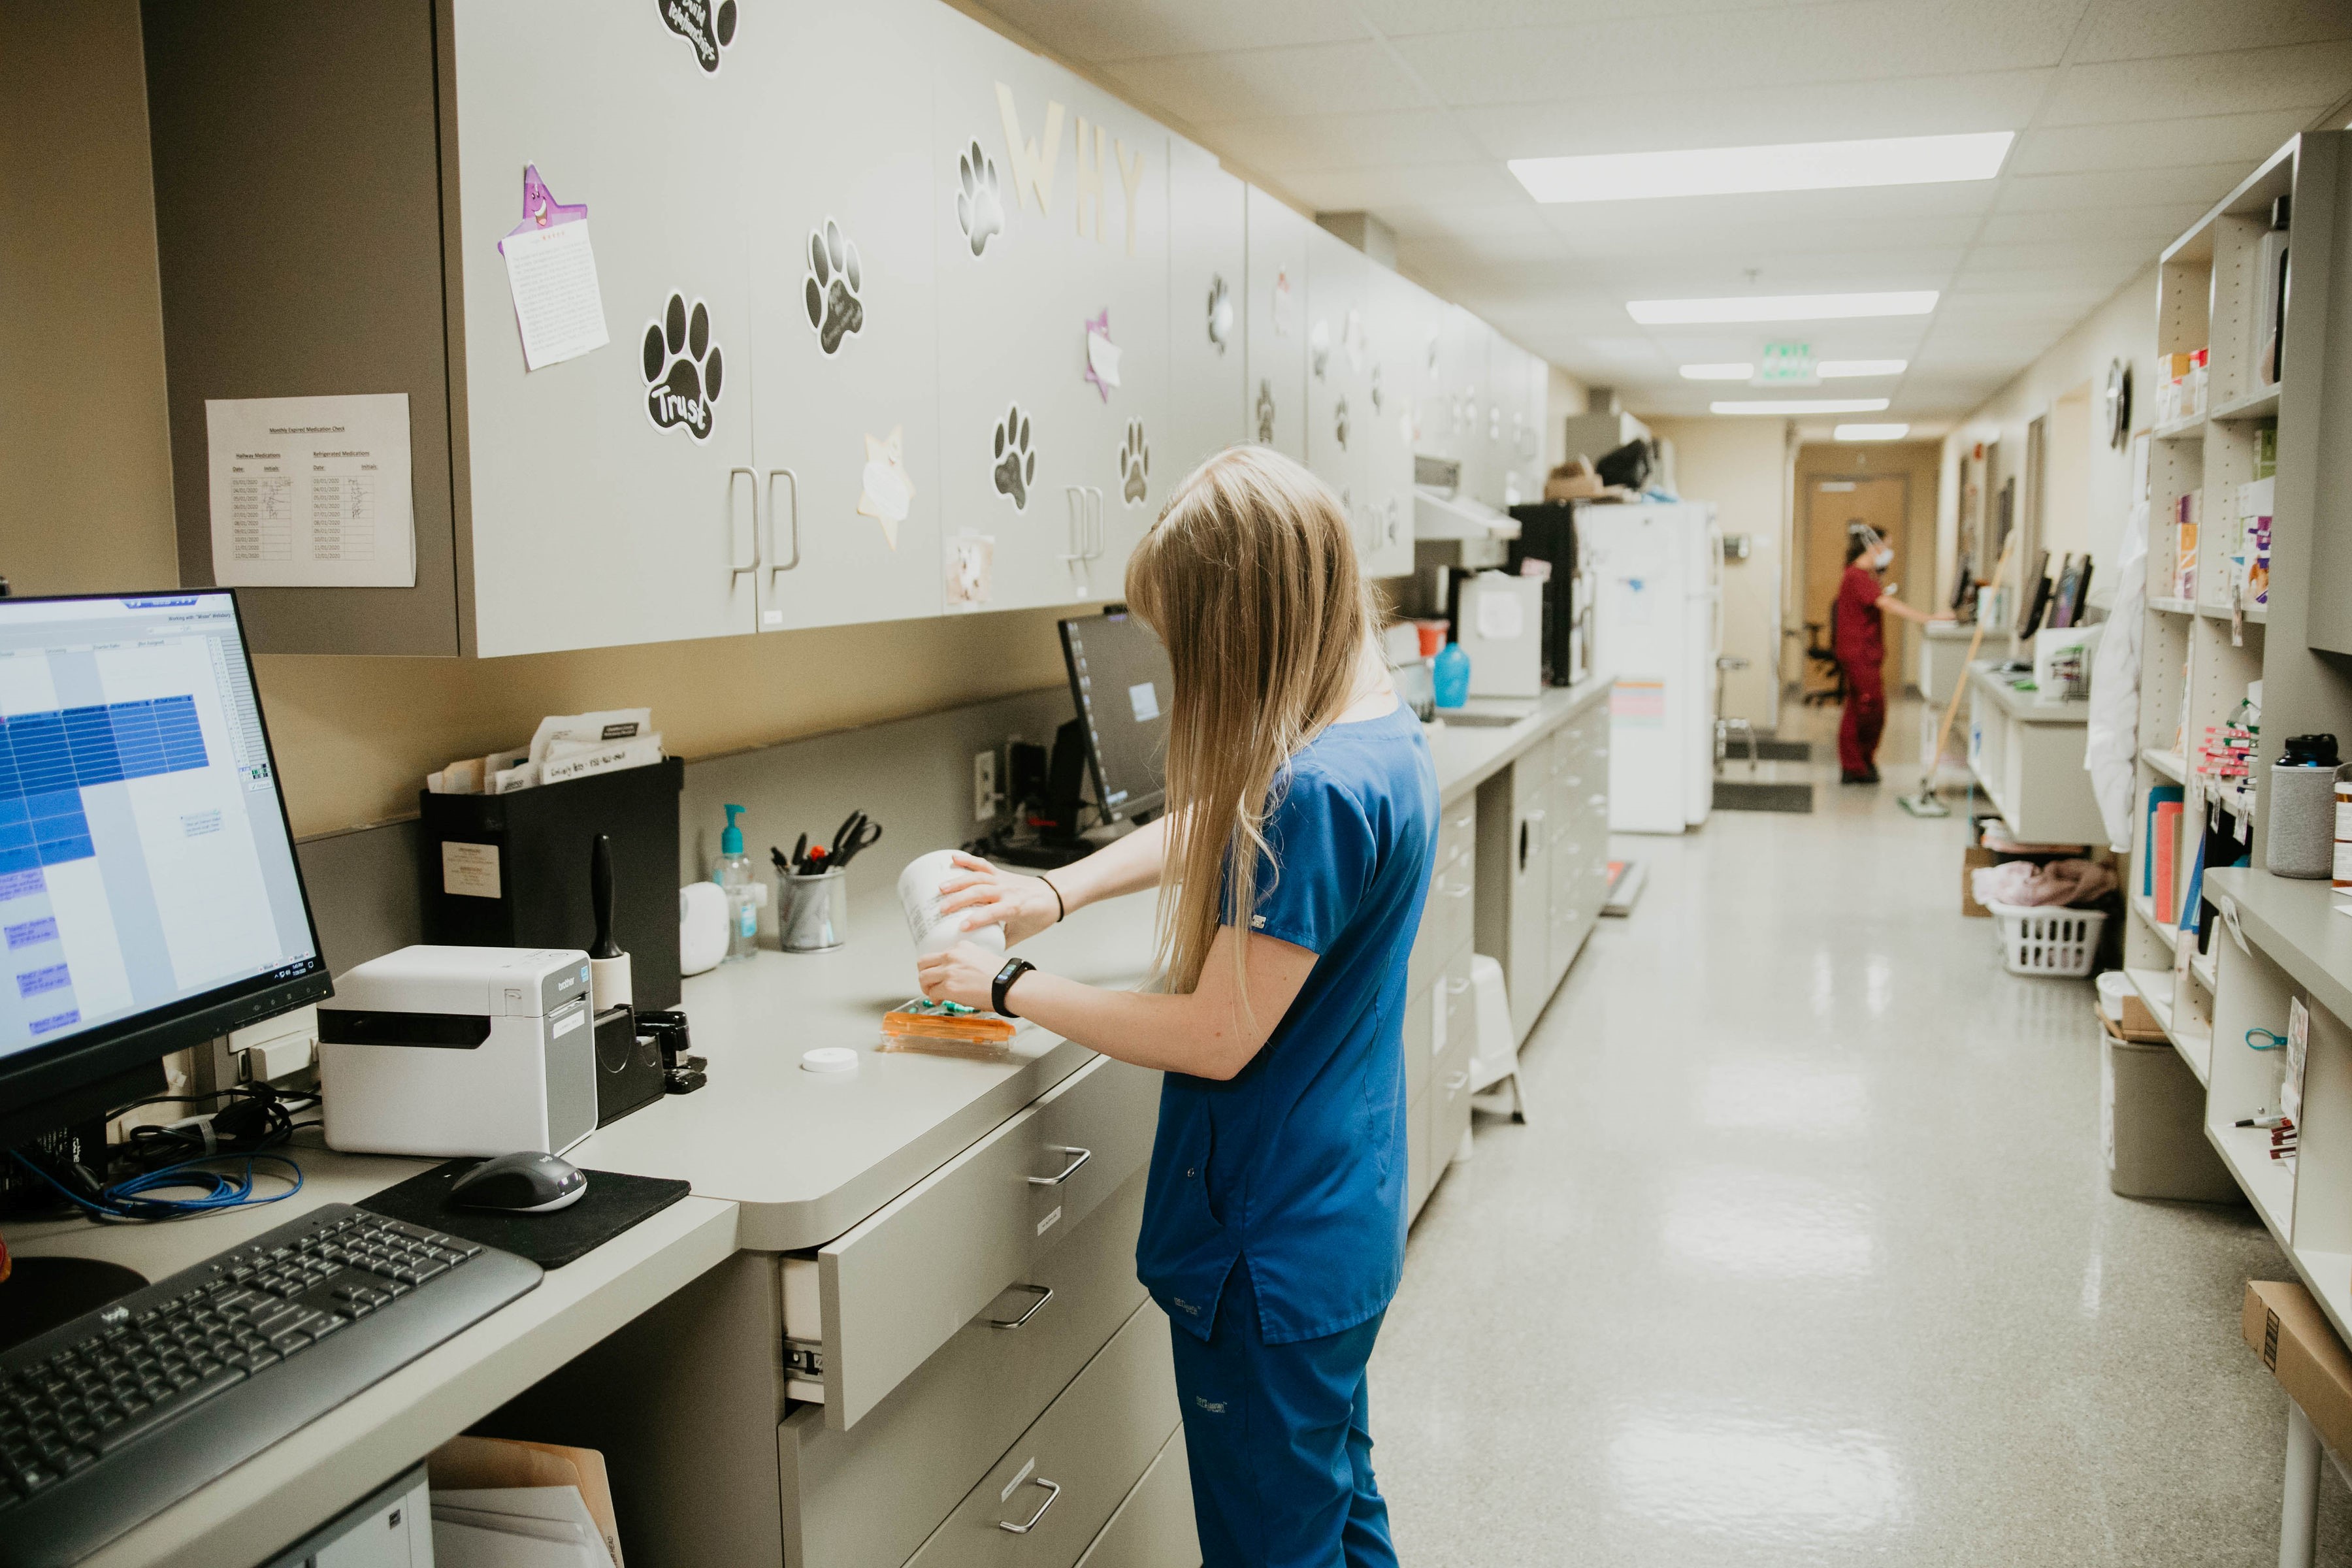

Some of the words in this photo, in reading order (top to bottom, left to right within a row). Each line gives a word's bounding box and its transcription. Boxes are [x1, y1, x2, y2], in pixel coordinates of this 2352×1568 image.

[995, 80, 1145, 257] WHY
[651, 385, 706, 430] Trust
[558, 977, 575, 991] brother
